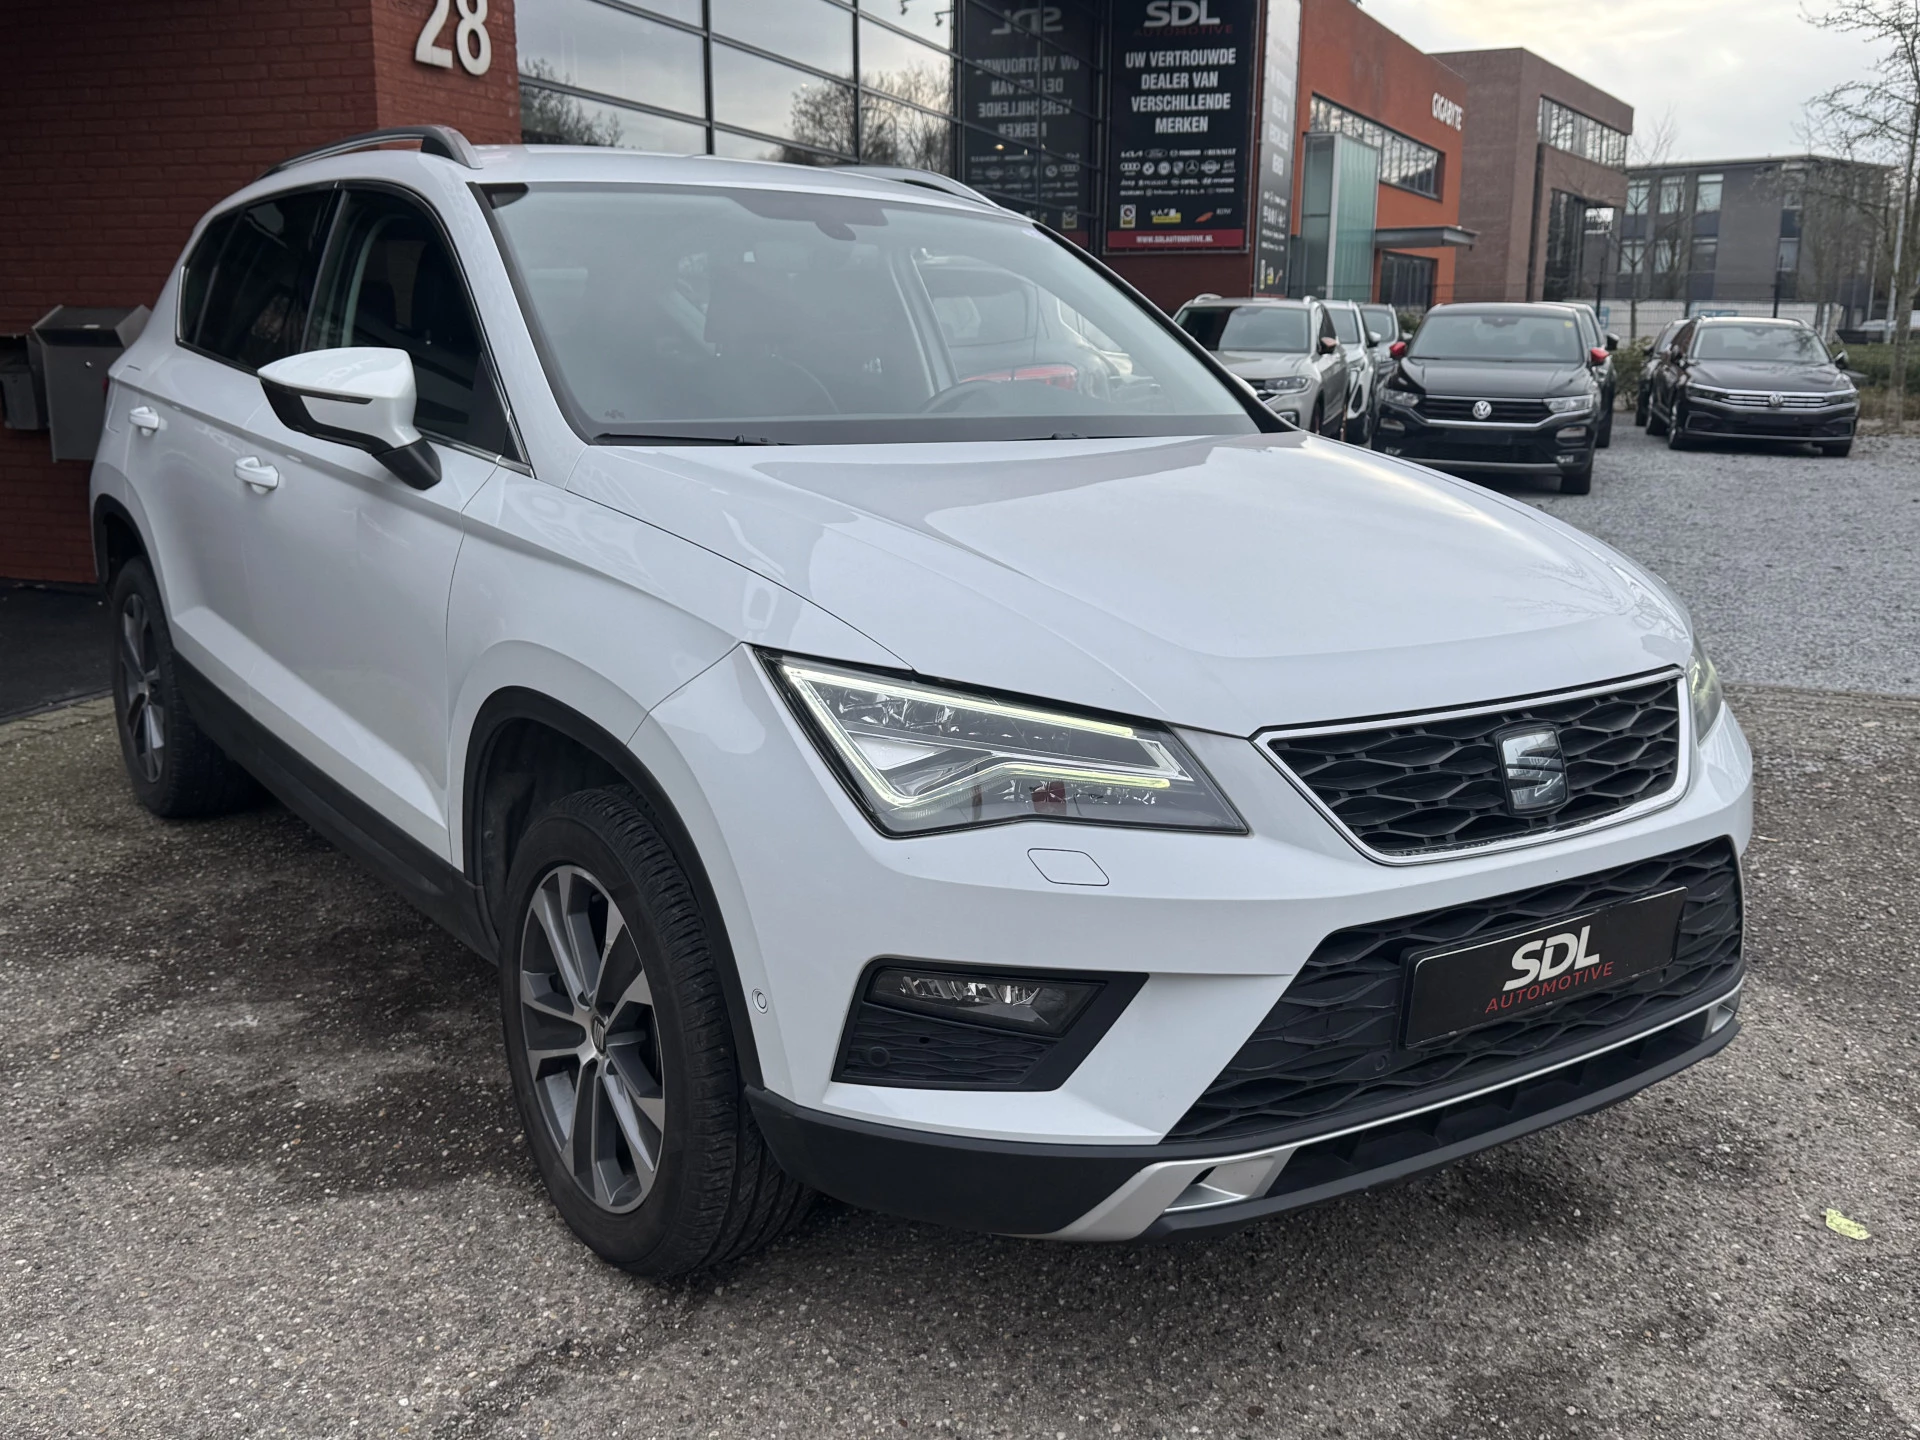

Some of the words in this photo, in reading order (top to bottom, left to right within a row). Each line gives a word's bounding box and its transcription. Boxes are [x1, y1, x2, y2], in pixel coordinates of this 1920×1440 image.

[1144, 0, 1222, 28] SDL
[414, 0, 492, 76] 28
[1125, 51, 1148, 69] UW
[1149, 47, 1237, 68] VERTROUWDE
[1141, 72, 1191, 91] DEALER
[1192, 71, 1219, 88] VAN
[1131, 93, 1232, 113] VERSCHILLENDE
[1154, 116, 1209, 134] MERKEN
[1502, 925, 1600, 992] SDL
[1485, 961, 1615, 1014] AUTOMOTIVE
